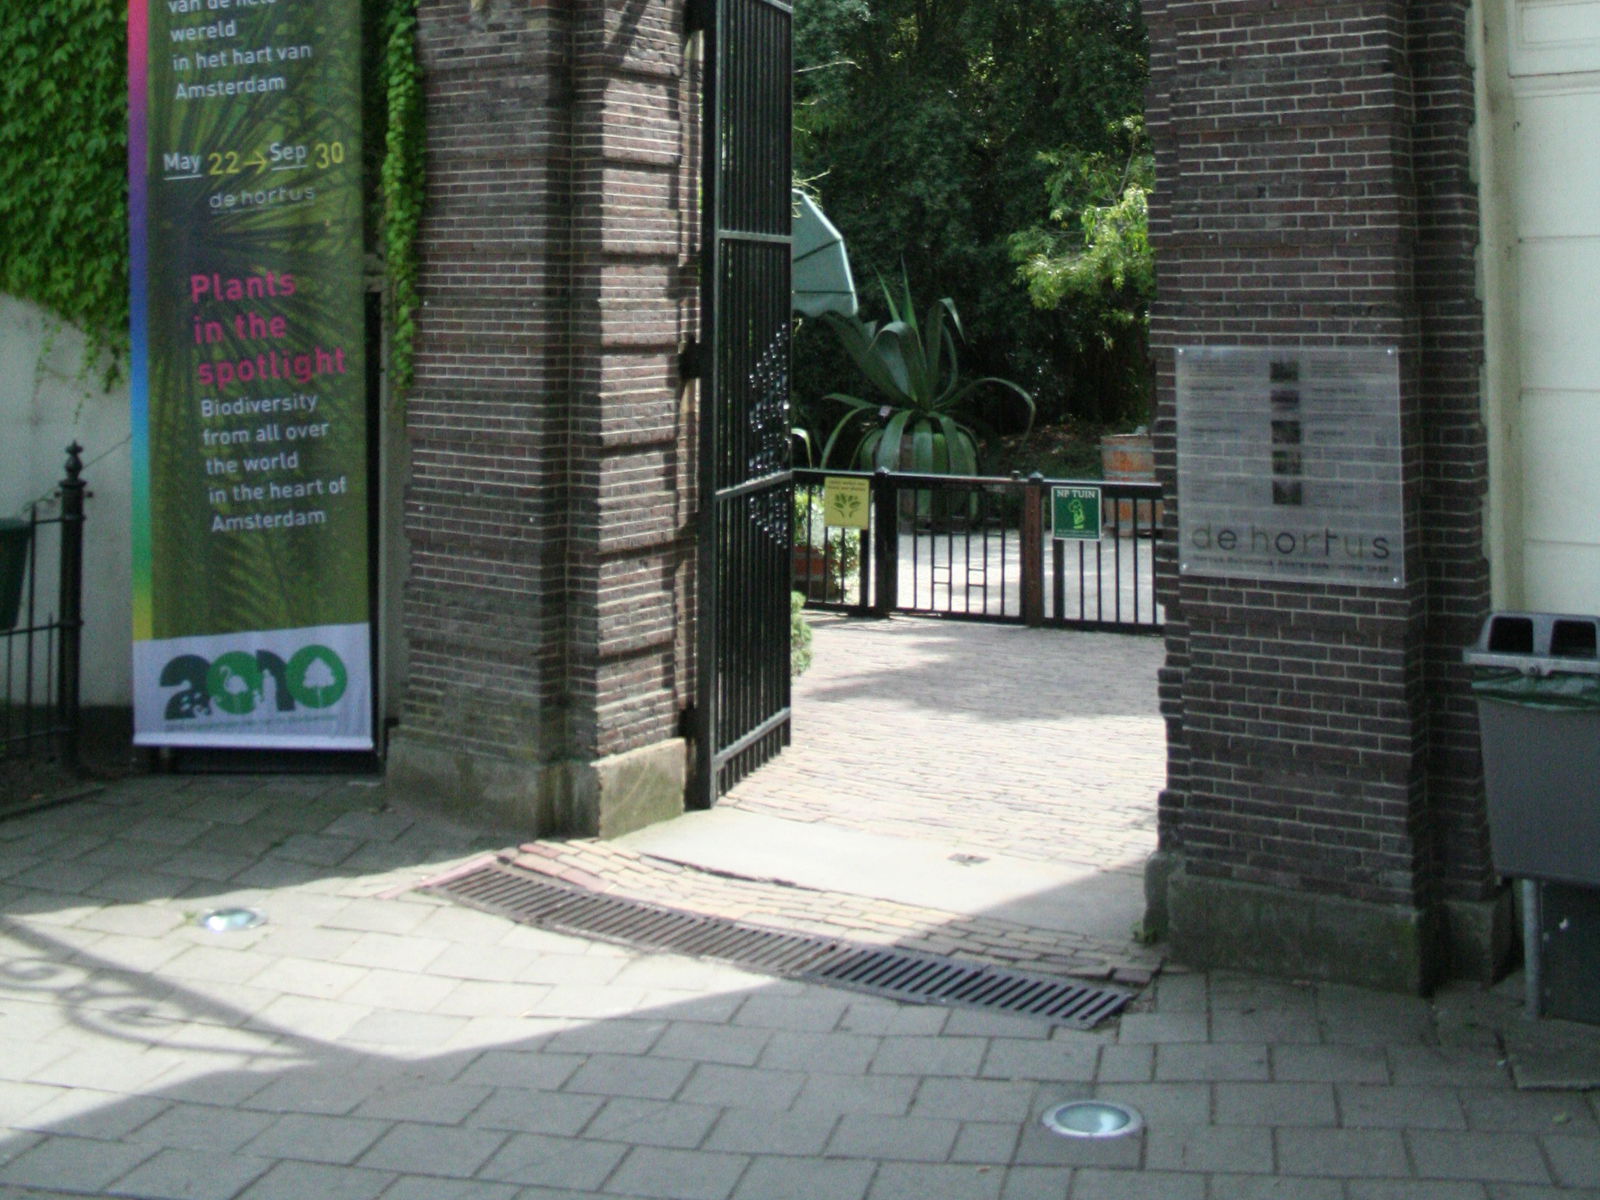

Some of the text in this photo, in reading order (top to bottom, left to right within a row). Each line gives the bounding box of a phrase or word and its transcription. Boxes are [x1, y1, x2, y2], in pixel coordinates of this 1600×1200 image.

[170, 19, 236, 43] wereld
[173, 45, 312, 71] in het hart van
[176, 75, 287, 100] Amsterdam
[163, 142, 344, 176] May 22 Sep 30
[209, 191, 236, 209] de
[241, 186, 316, 205] hortus
[191, 271, 296, 304] Plants
[193, 311, 287, 344] in the
[198, 346, 346, 391] spotlight
[201, 393, 318, 418] Biodiversity
[203, 422, 329, 446] from all over
[206, 451, 299, 475] the world
[209, 476, 347, 504] in the heart of
[1071, 490, 1096, 498] TUIN
[212, 510, 326, 533] Amsterdam
[1191, 524, 1390, 559] de hortus
